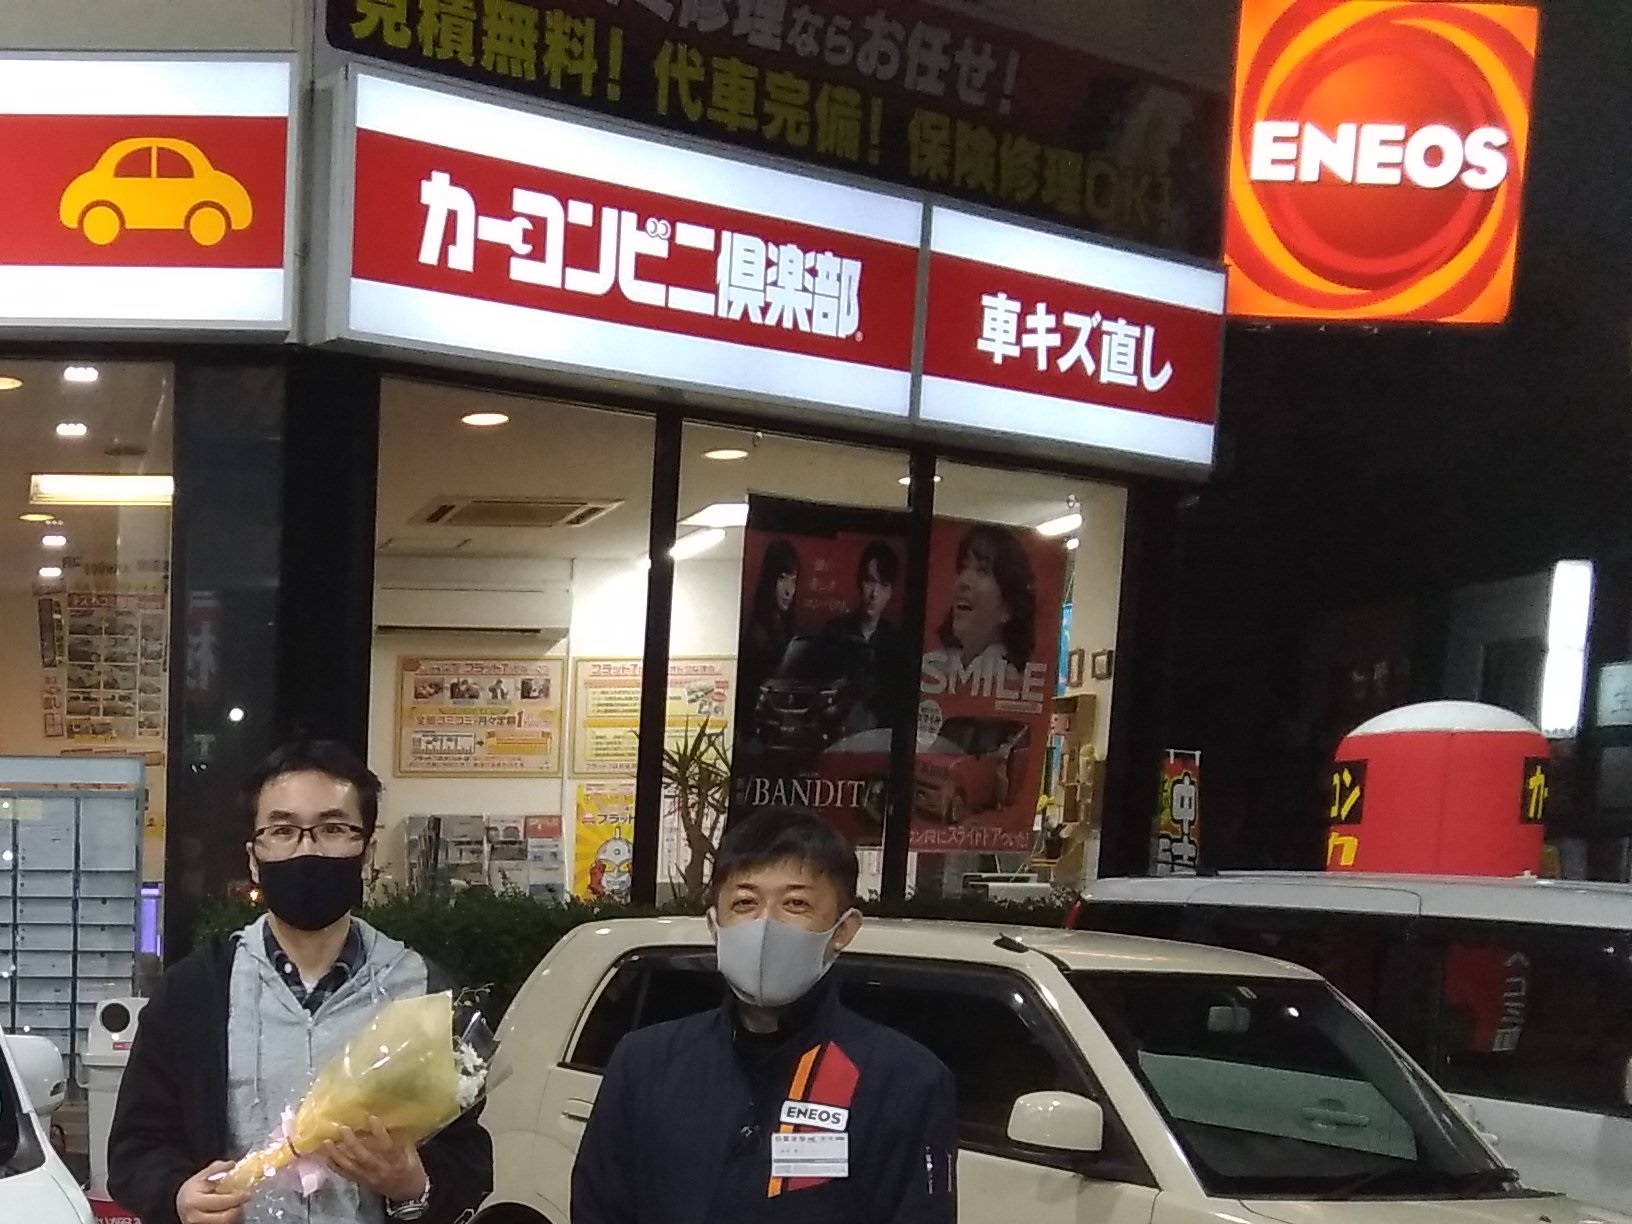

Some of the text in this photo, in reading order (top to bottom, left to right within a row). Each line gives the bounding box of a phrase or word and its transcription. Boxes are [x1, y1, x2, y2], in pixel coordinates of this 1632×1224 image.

[350, 0, 622, 102] 見積無料!
[655, 41, 882, 165] 代車完備!
[606, 0, 1020, 116] 修理ならお任せ!
[1250, 120, 1510, 191] ENEOS
[417, 169, 864, 342] カーコンビニ倶楽部
[977, 291, 1174, 394] 車キズ直し
[591, 663, 642, 675] フラット7
[920, 653, 1049, 702] SMILE
[785, 1105, 842, 1125] ENEOS
